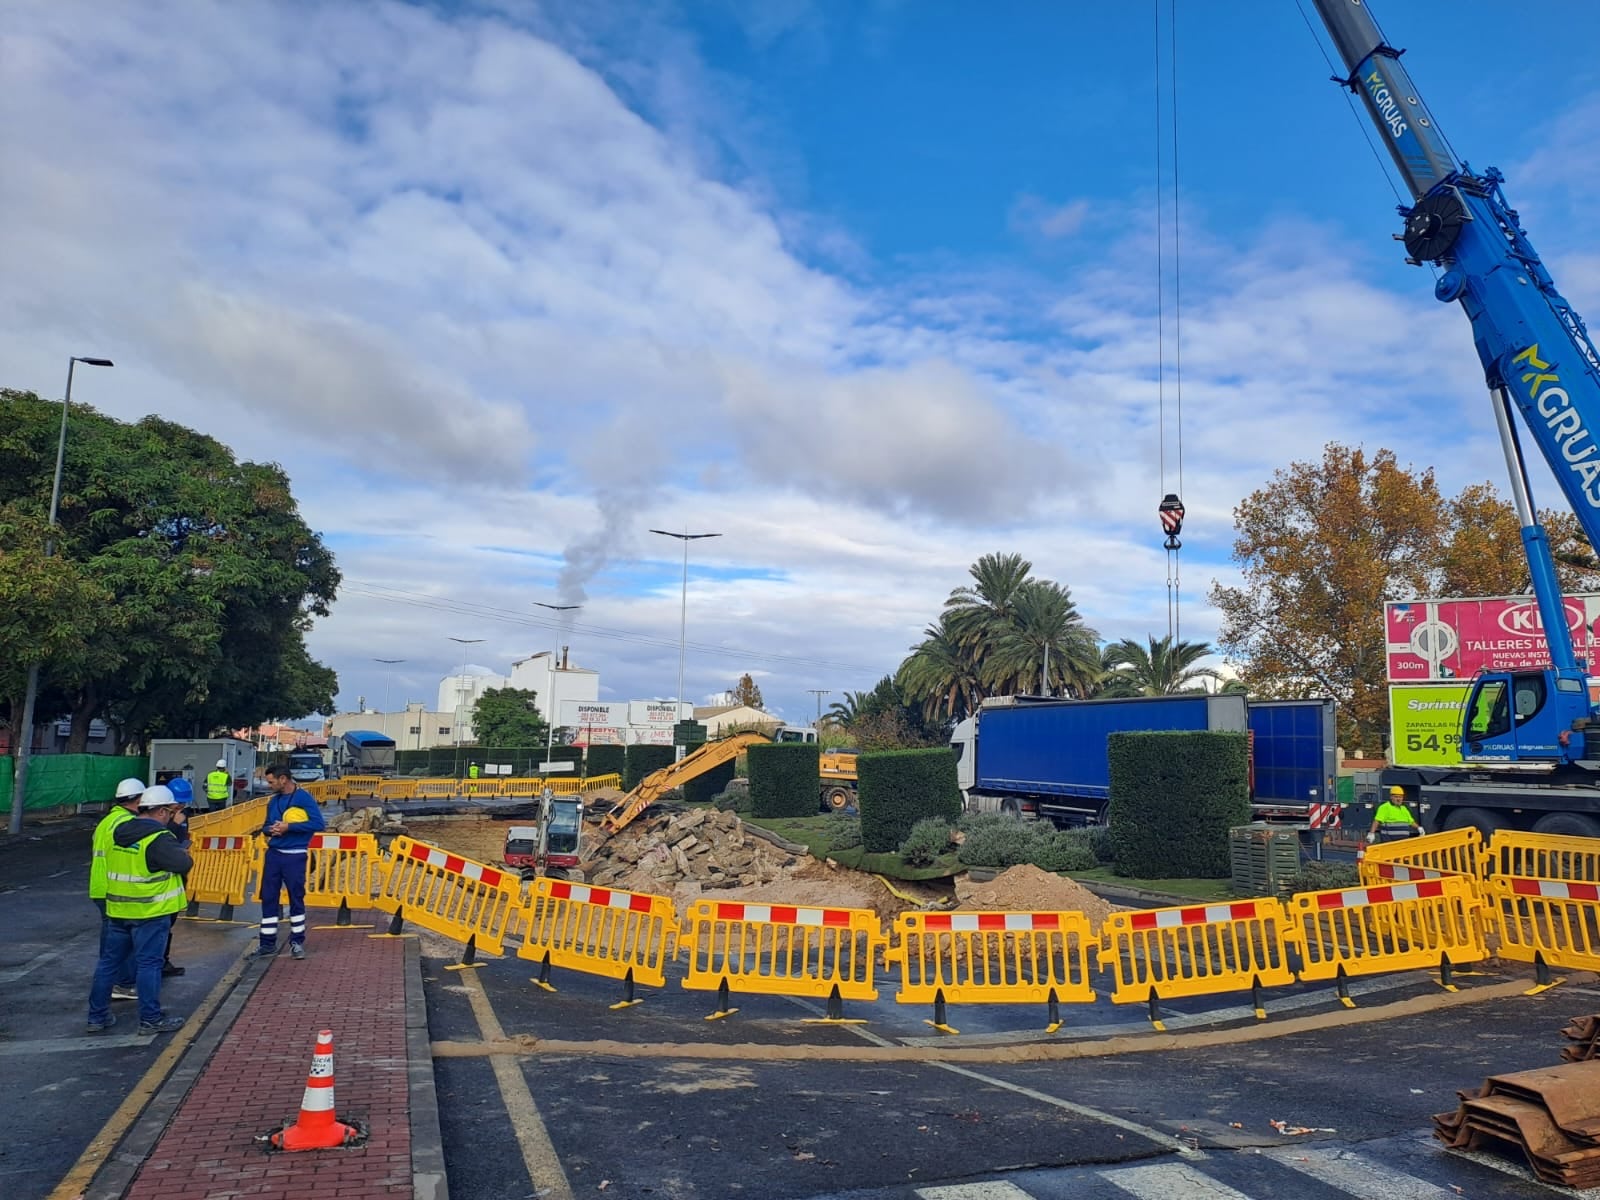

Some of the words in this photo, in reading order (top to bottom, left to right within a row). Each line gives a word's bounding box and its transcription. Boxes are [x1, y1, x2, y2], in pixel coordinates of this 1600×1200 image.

[1466, 640, 1532, 650] TALLERES
[1397, 661, 1424, 669] 300m
[1520, 659, 1532, 667] de
[578, 705, 610, 713] DISPONIBLE
[647, 704, 677, 712] DISPONIBLE
[1408, 699, 1467, 711] Sprinte
